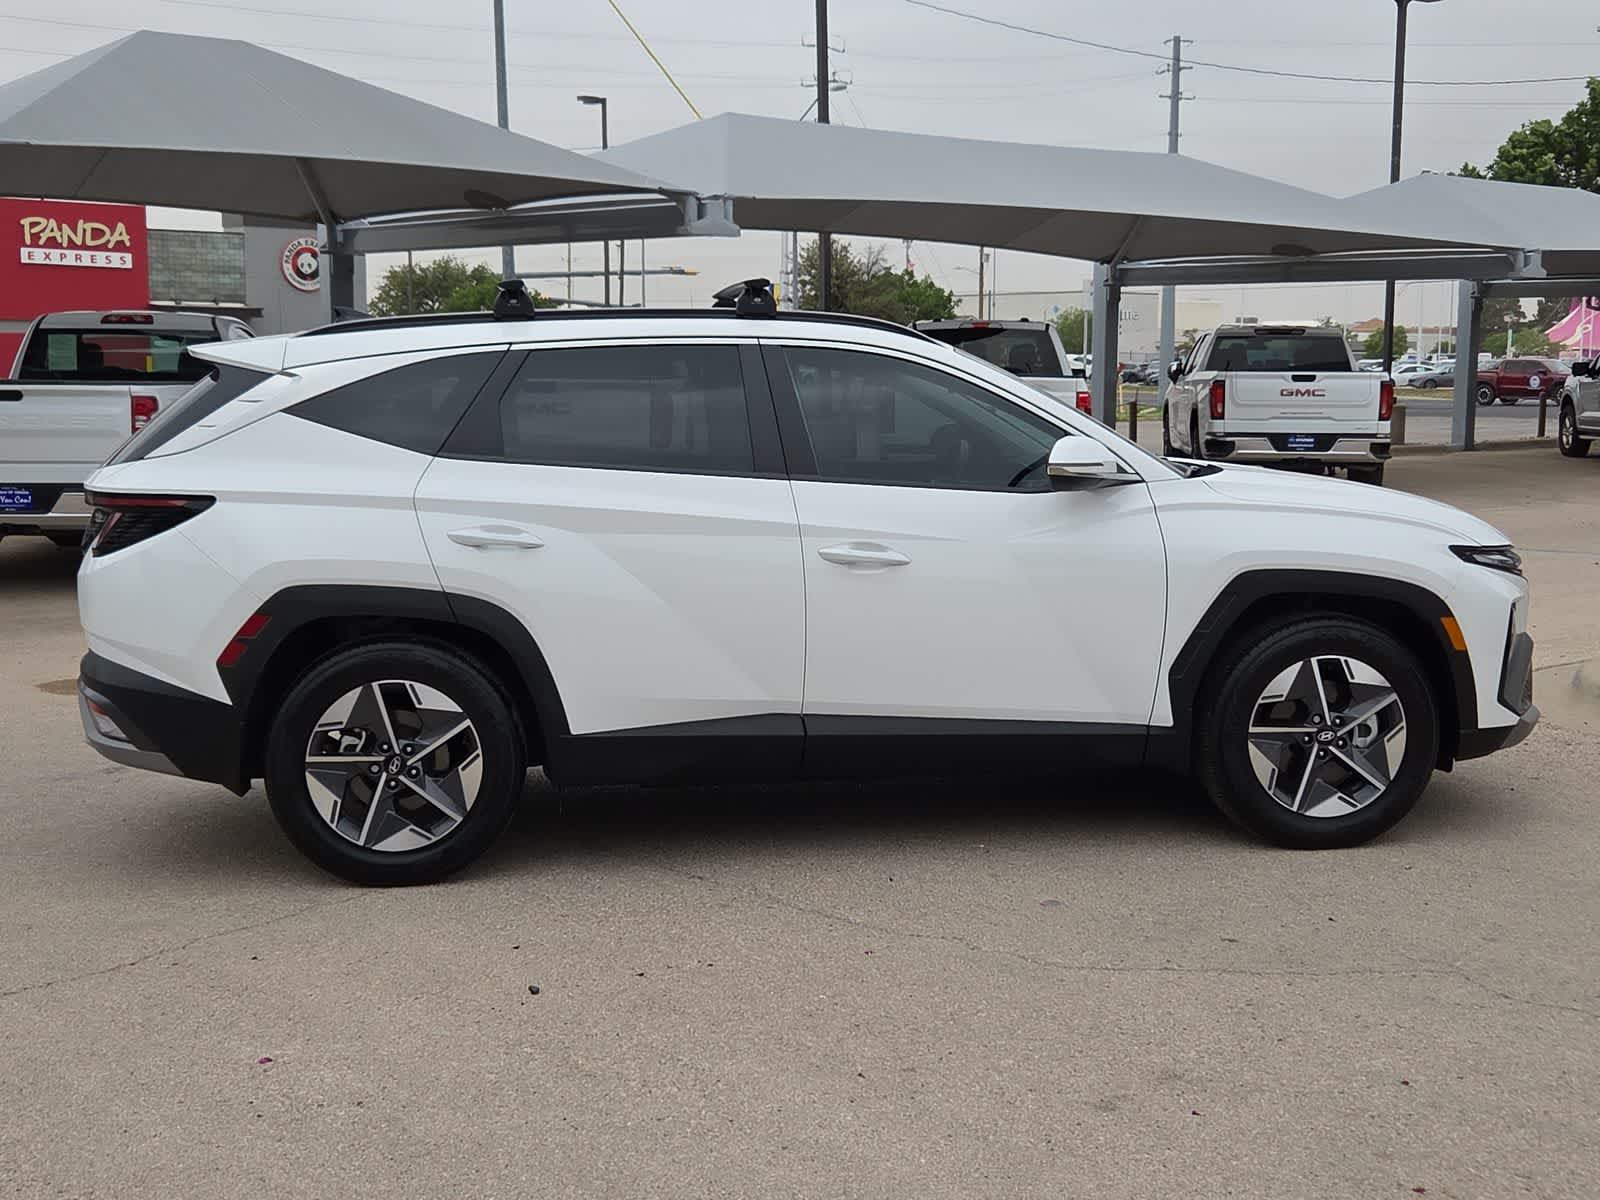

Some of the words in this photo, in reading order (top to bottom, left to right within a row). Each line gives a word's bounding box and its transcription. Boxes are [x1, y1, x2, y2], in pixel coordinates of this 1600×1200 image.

[20, 216, 131, 249] PANDA
[27, 251, 128, 266] EXPRESS
[1280, 388, 1326, 398] GMC
